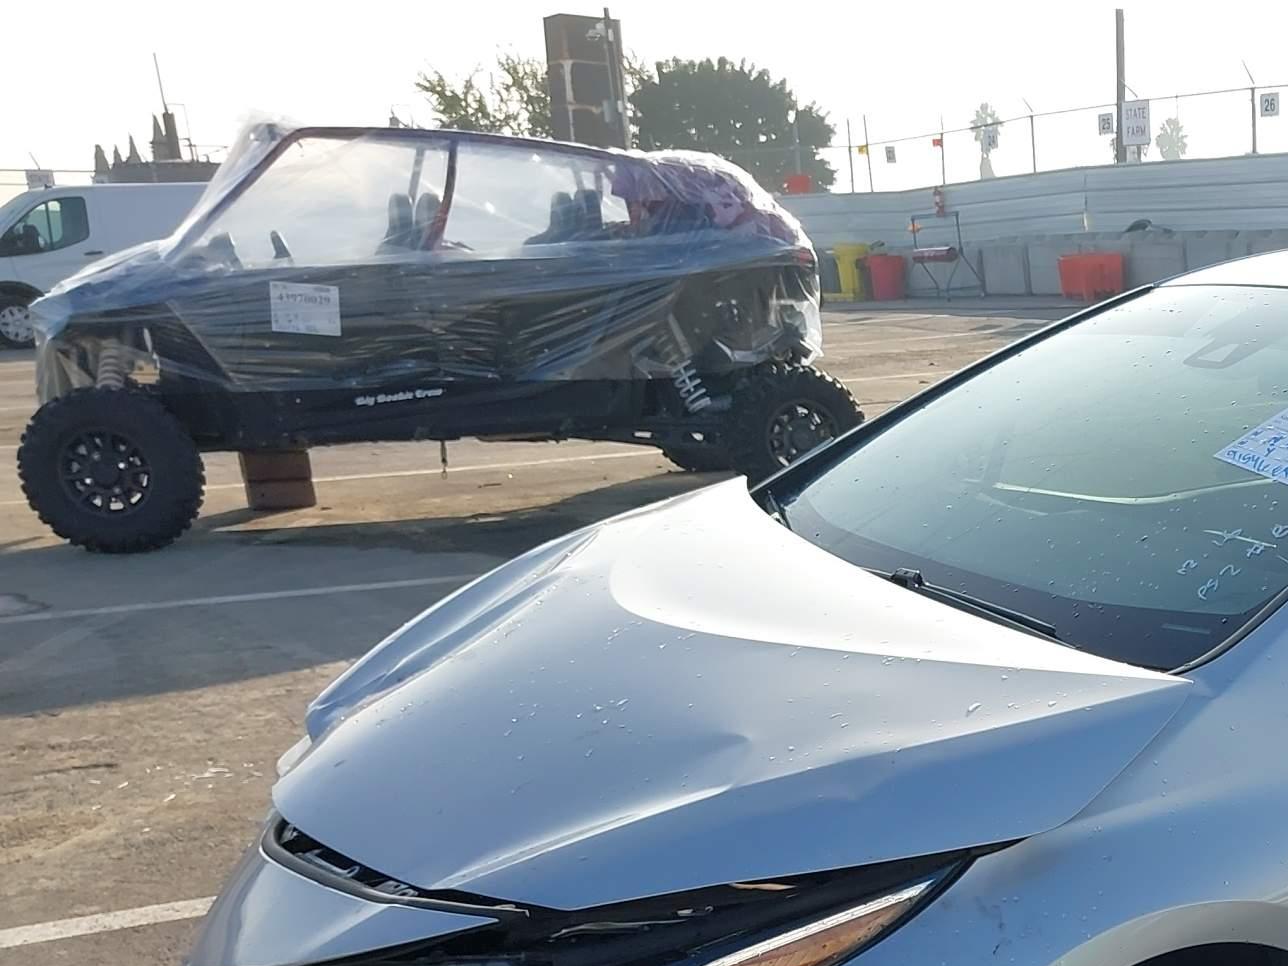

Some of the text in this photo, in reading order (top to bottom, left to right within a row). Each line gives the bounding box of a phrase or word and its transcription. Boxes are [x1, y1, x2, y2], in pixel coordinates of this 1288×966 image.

[1263, 98, 1276, 112] 26
[1125, 106, 1147, 120] STATE
[1102, 117, 1111, 130] 25
[1126, 125, 1146, 137] FARM
